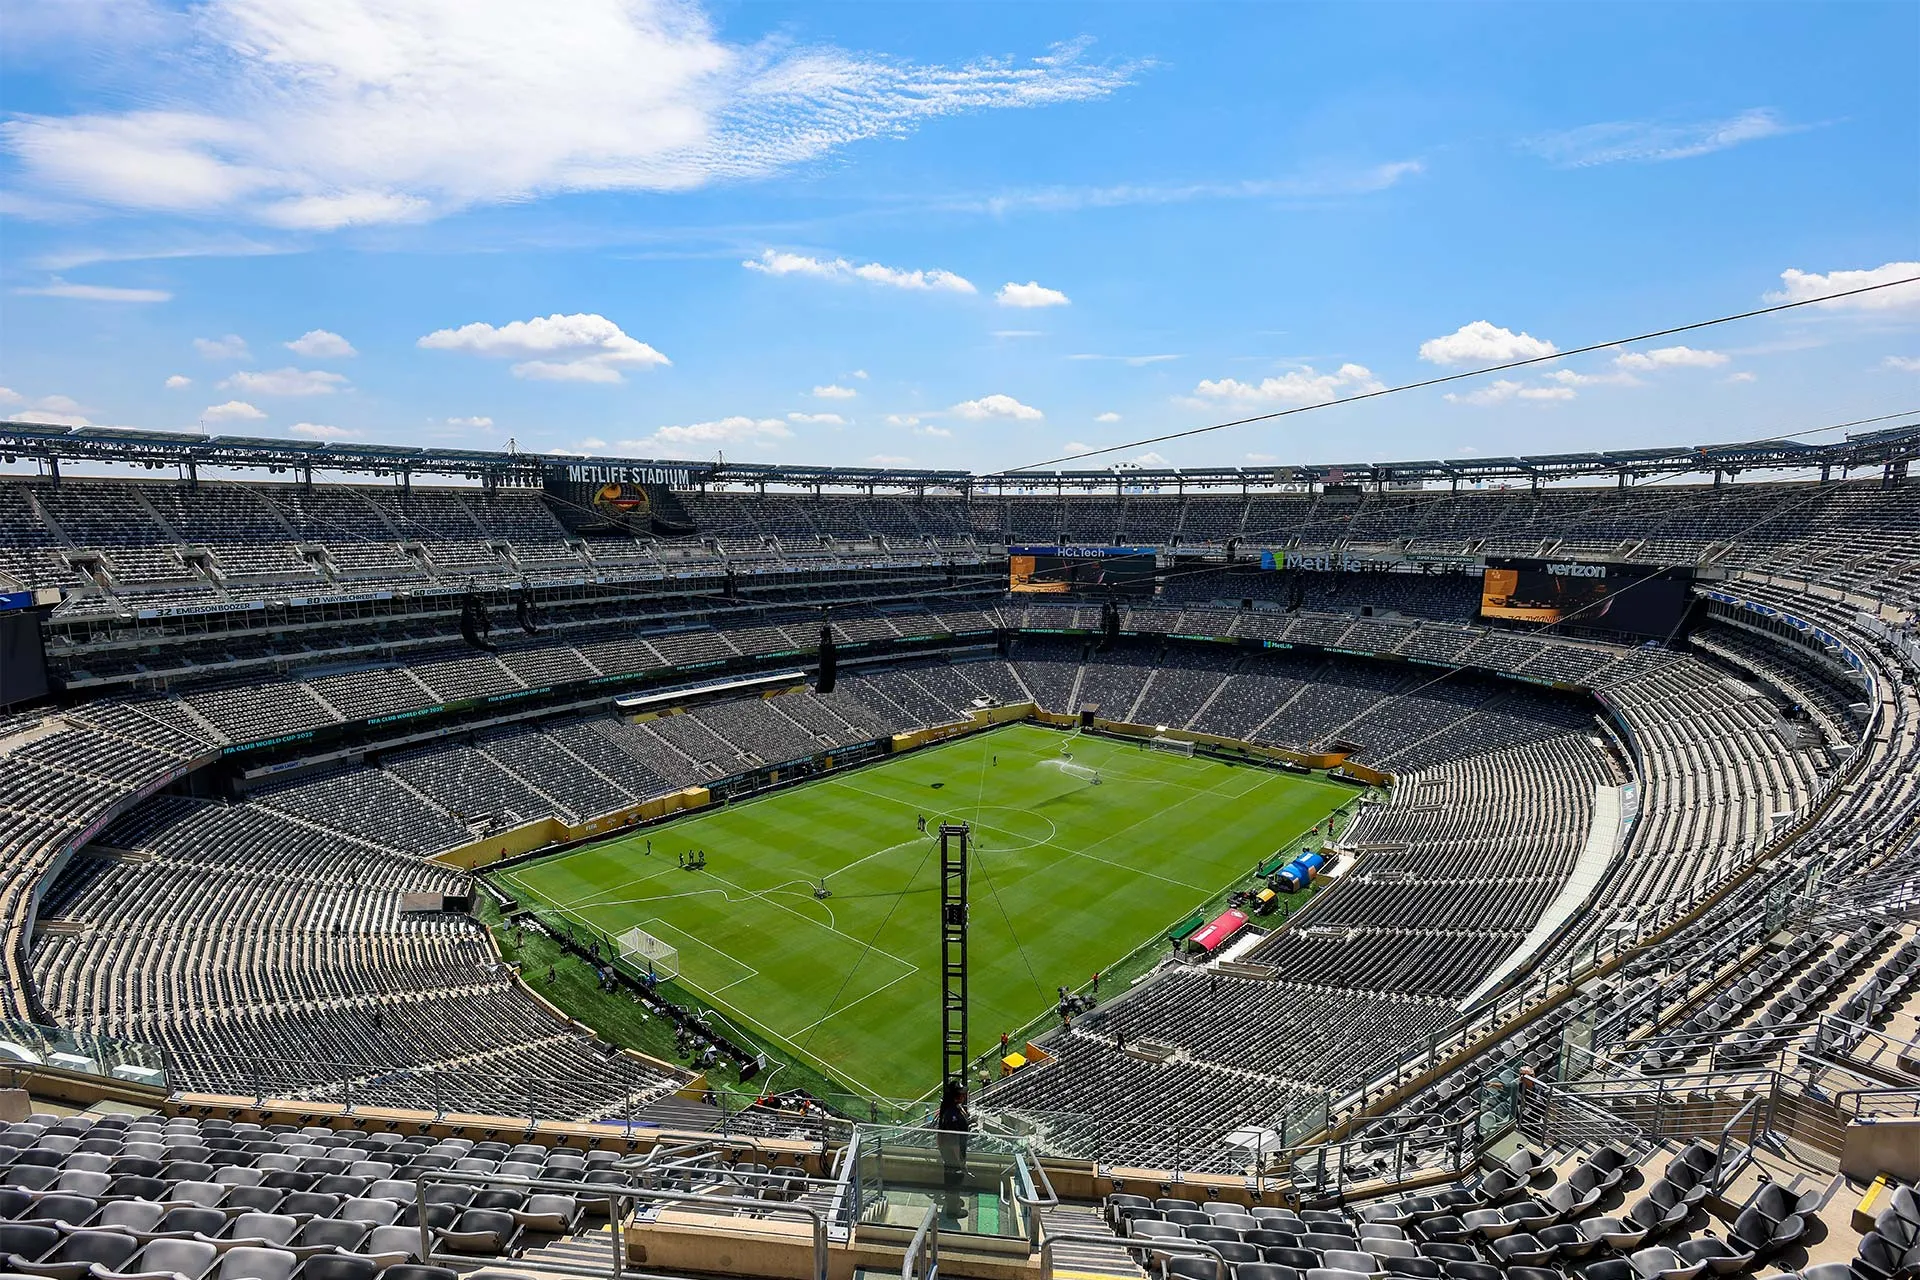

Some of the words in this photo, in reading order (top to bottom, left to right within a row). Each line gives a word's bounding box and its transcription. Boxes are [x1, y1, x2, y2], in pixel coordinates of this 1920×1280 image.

[568, 466, 628, 482] METLIFE
[632, 468, 689, 484] STADIUM
[1058, 548, 1104, 557] HCLTech
[1286, 554, 1361, 572] MetLfe
[1546, 562, 1606, 578] verizon
[348, 593, 378, 602] CHREBET
[156, 609, 172, 617] 32
[176, 606, 217, 615] EMERSON
[218, 603, 250, 612] BOOZER
[367, 717, 380, 725] FIFA
[381, 714, 396, 722] CLUB
[396, 710, 417, 719] WORLD
[236, 742, 255, 752] CLUB
[255, 737, 281, 748] WORLD
[282, 734, 295, 742] CUP
